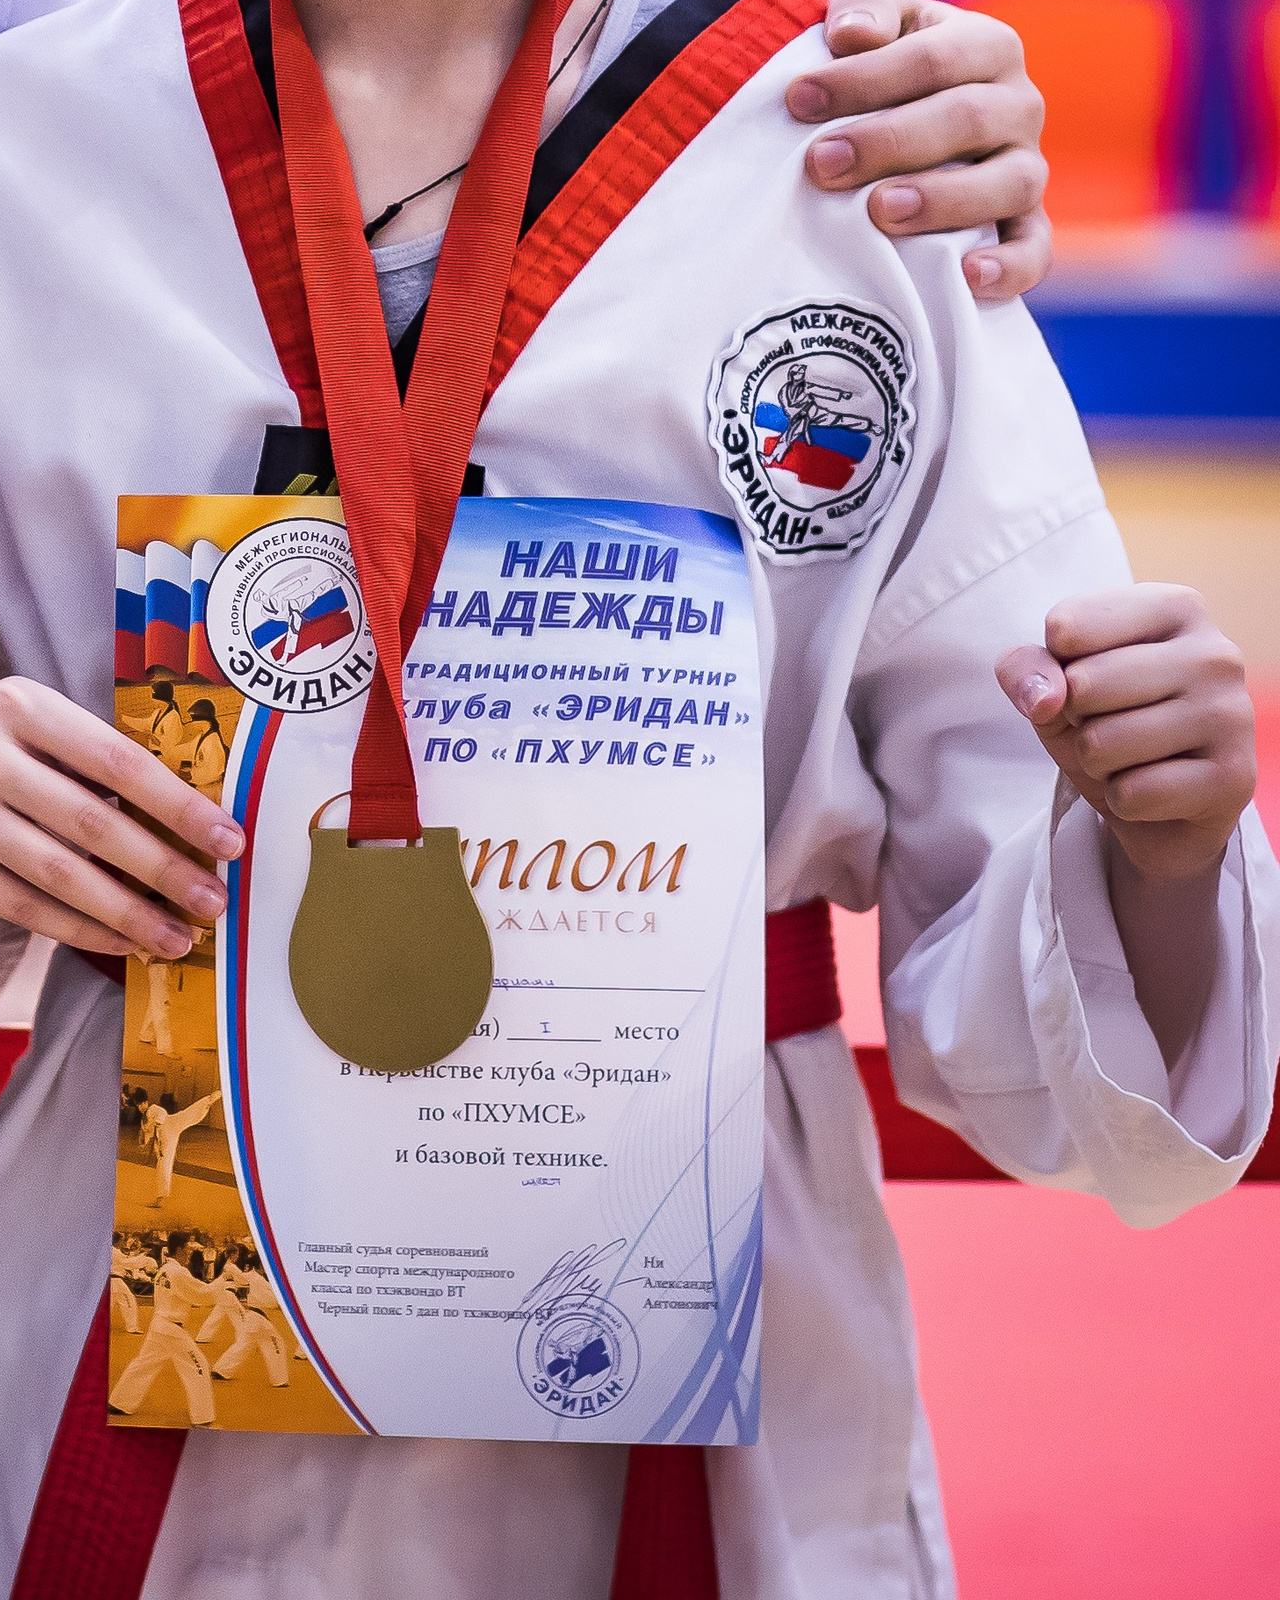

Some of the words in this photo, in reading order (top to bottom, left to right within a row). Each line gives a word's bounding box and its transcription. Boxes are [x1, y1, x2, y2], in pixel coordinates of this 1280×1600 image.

[723, 423, 811, 545] ЭРИДАН
[500, 540, 679, 583] НАШИ
[230, 560, 264, 636] СПОРТИВНЫЙ
[264, 545, 359, 582] ПРОФЕССИОНАЛЬ
[421, 590, 725, 640] НАДЕЖДЫ
[229, 650, 373, 710] ЭРИДАН
[406, 662, 629, 682] ТРАДИЦИОННЫЙ
[641, 667, 737, 686] ТУРНИР
[533, 694, 750, 729] «ЭРИДАН»
[423, 738, 478, 762] ПО
[492, 738, 716, 767] «ПХУМСЕ»
[461, 838, 689, 893] плом
[495, 908, 657, 933] ЖДАЕТСЯ
[615, 1025, 680, 1040] место
[340, 1062, 351, 1075] в
[491, 1061, 556, 1086] клуба
[564, 1063, 671, 1087] «Эридан»
[418, 1107, 445, 1121] по
[452, 1102, 586, 1124] «ПХУМСЕ»
[395, 1149, 408, 1163] и
[416, 1144, 505, 1166] базовой
[513, 1153, 608, 1168] технике.
[298, 1241, 353, 1253] Главный
[356, 1246, 392, 1258] судья
[396, 1246, 489, 1259] соревнований
[643, 1256, 664, 1268] Ни
[304, 1261, 352, 1277] Мастер
[355, 1266, 400, 1278] спорта
[403, 1267, 515, 1281] международного
[311, 1284, 352, 1294] класса
[356, 1285, 372, 1295] по
[377, 1287, 443, 1297] тхэквондо
[447, 1286, 466, 1297] ВТ
[643, 1278, 714, 1293] Александр
[318, 1301, 368, 1316] Черный
[372, 1305, 403, 1316] пояс
[405, 1304, 413, 1316] 5
[417, 1307, 439, 1318] дан
[443, 1308, 459, 1317] по
[643, 1298, 718, 1309] Антонович
[533, 1377, 624, 1415] ЭРИДАН
